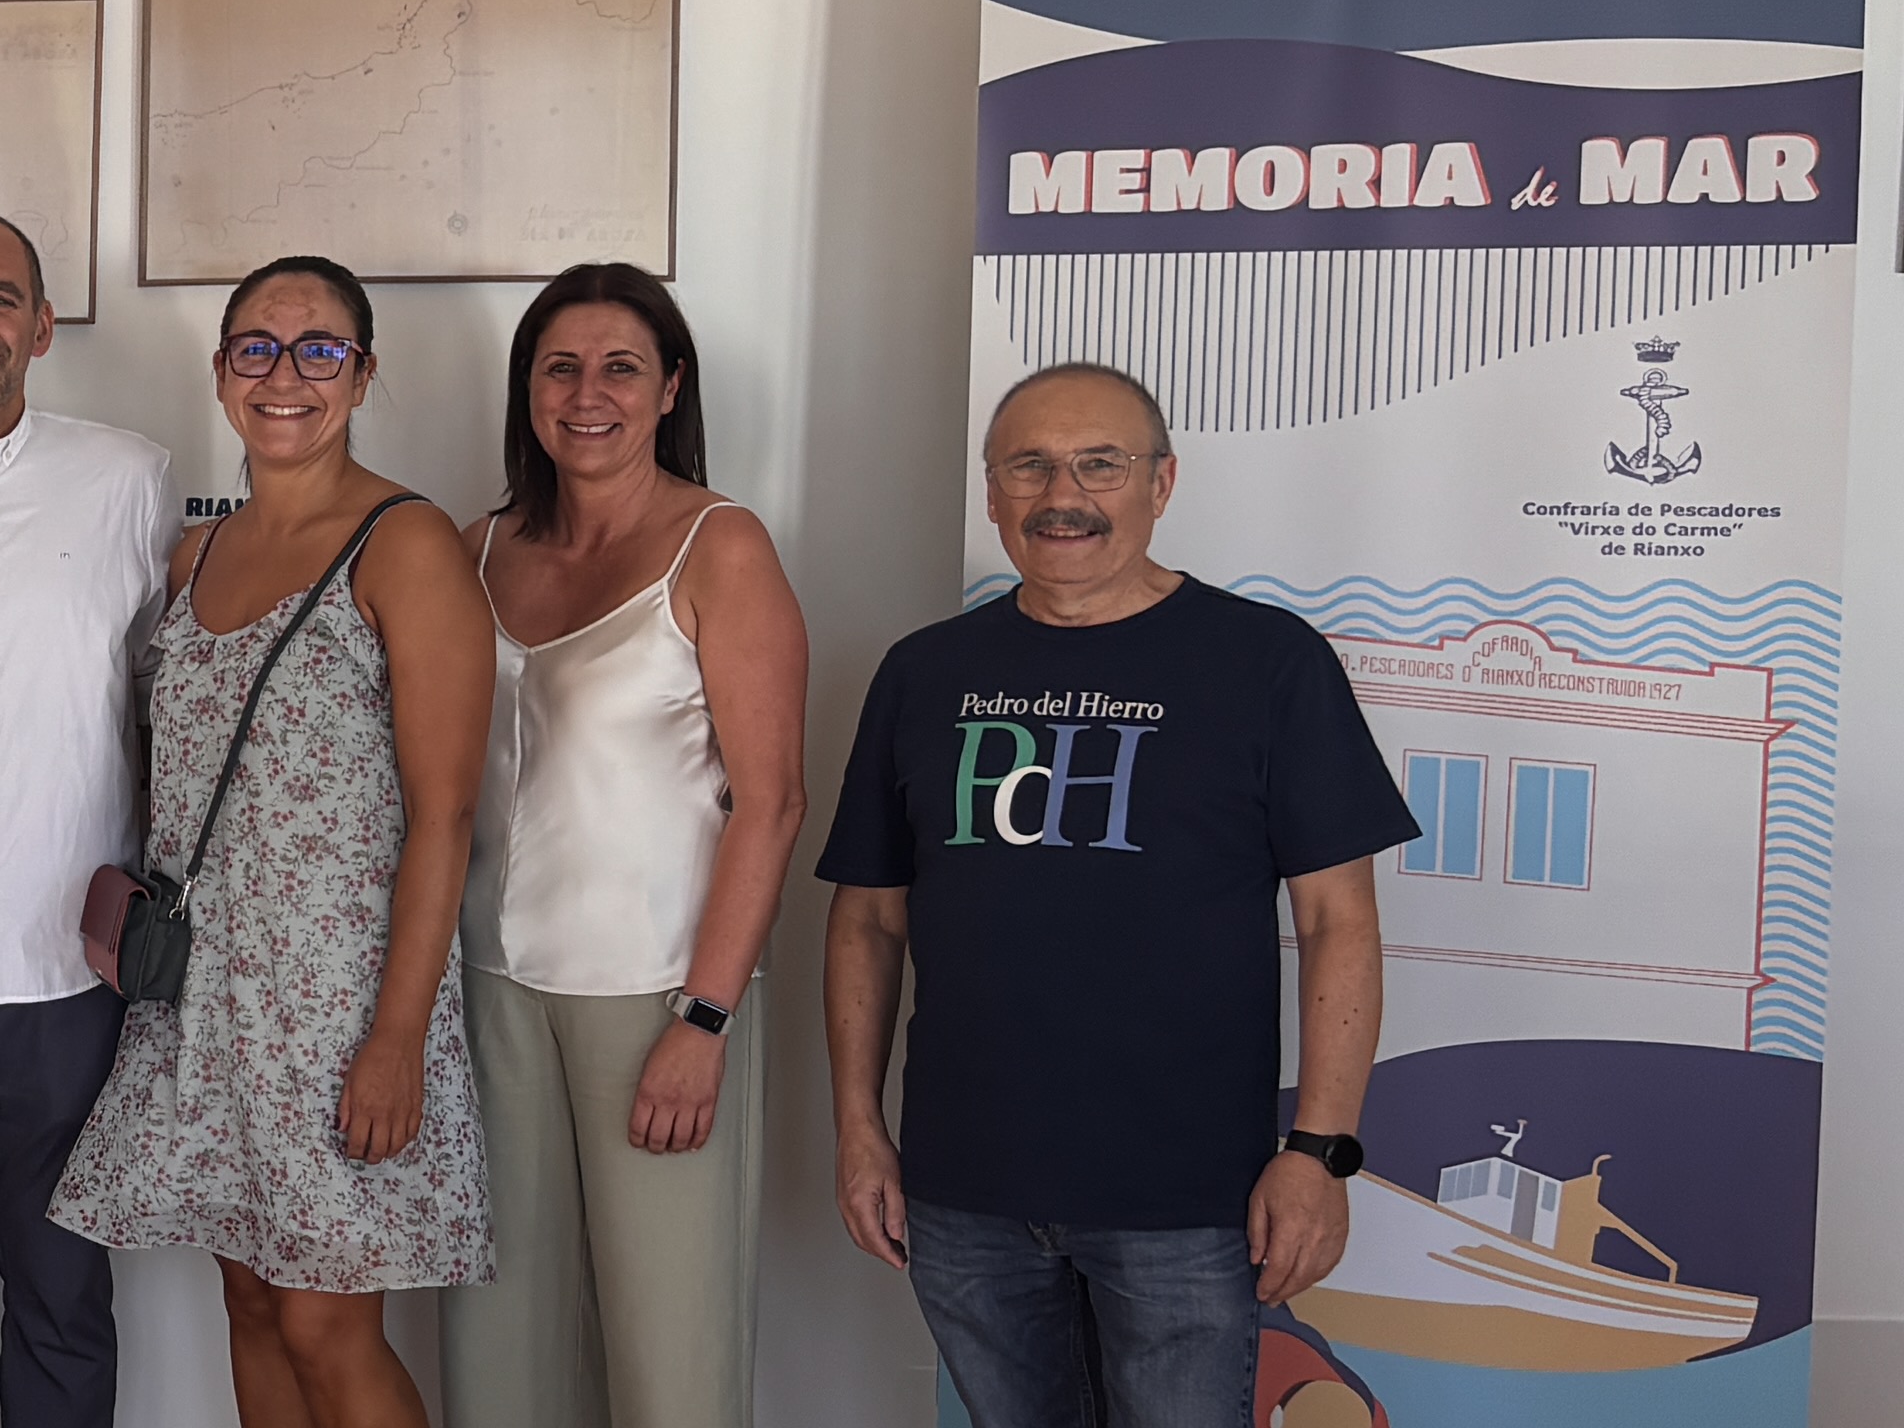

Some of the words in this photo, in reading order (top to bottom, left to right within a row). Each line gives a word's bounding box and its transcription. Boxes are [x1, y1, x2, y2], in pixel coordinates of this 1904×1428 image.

[1008, 142, 1491, 214] MEMORIA
[1510, 167, 1558, 211] de
[1579, 134, 1821, 205] MAR
[1522, 502, 1620, 516] Confraría
[1627, 503, 1653, 517] de
[1660, 503, 1782, 518] Pescadores
[1632, 522, 1657, 537] do
[1601, 542, 1626, 556] de
[1633, 542, 1705, 557] Rianxo
[1360, 656, 1455, 682] PESCADORES
[1649, 683, 1683, 702] 1927
[959, 691, 1028, 717] Pedro
[1033, 691, 1072, 717] del
[1076, 692, 1164, 720] Hierro
